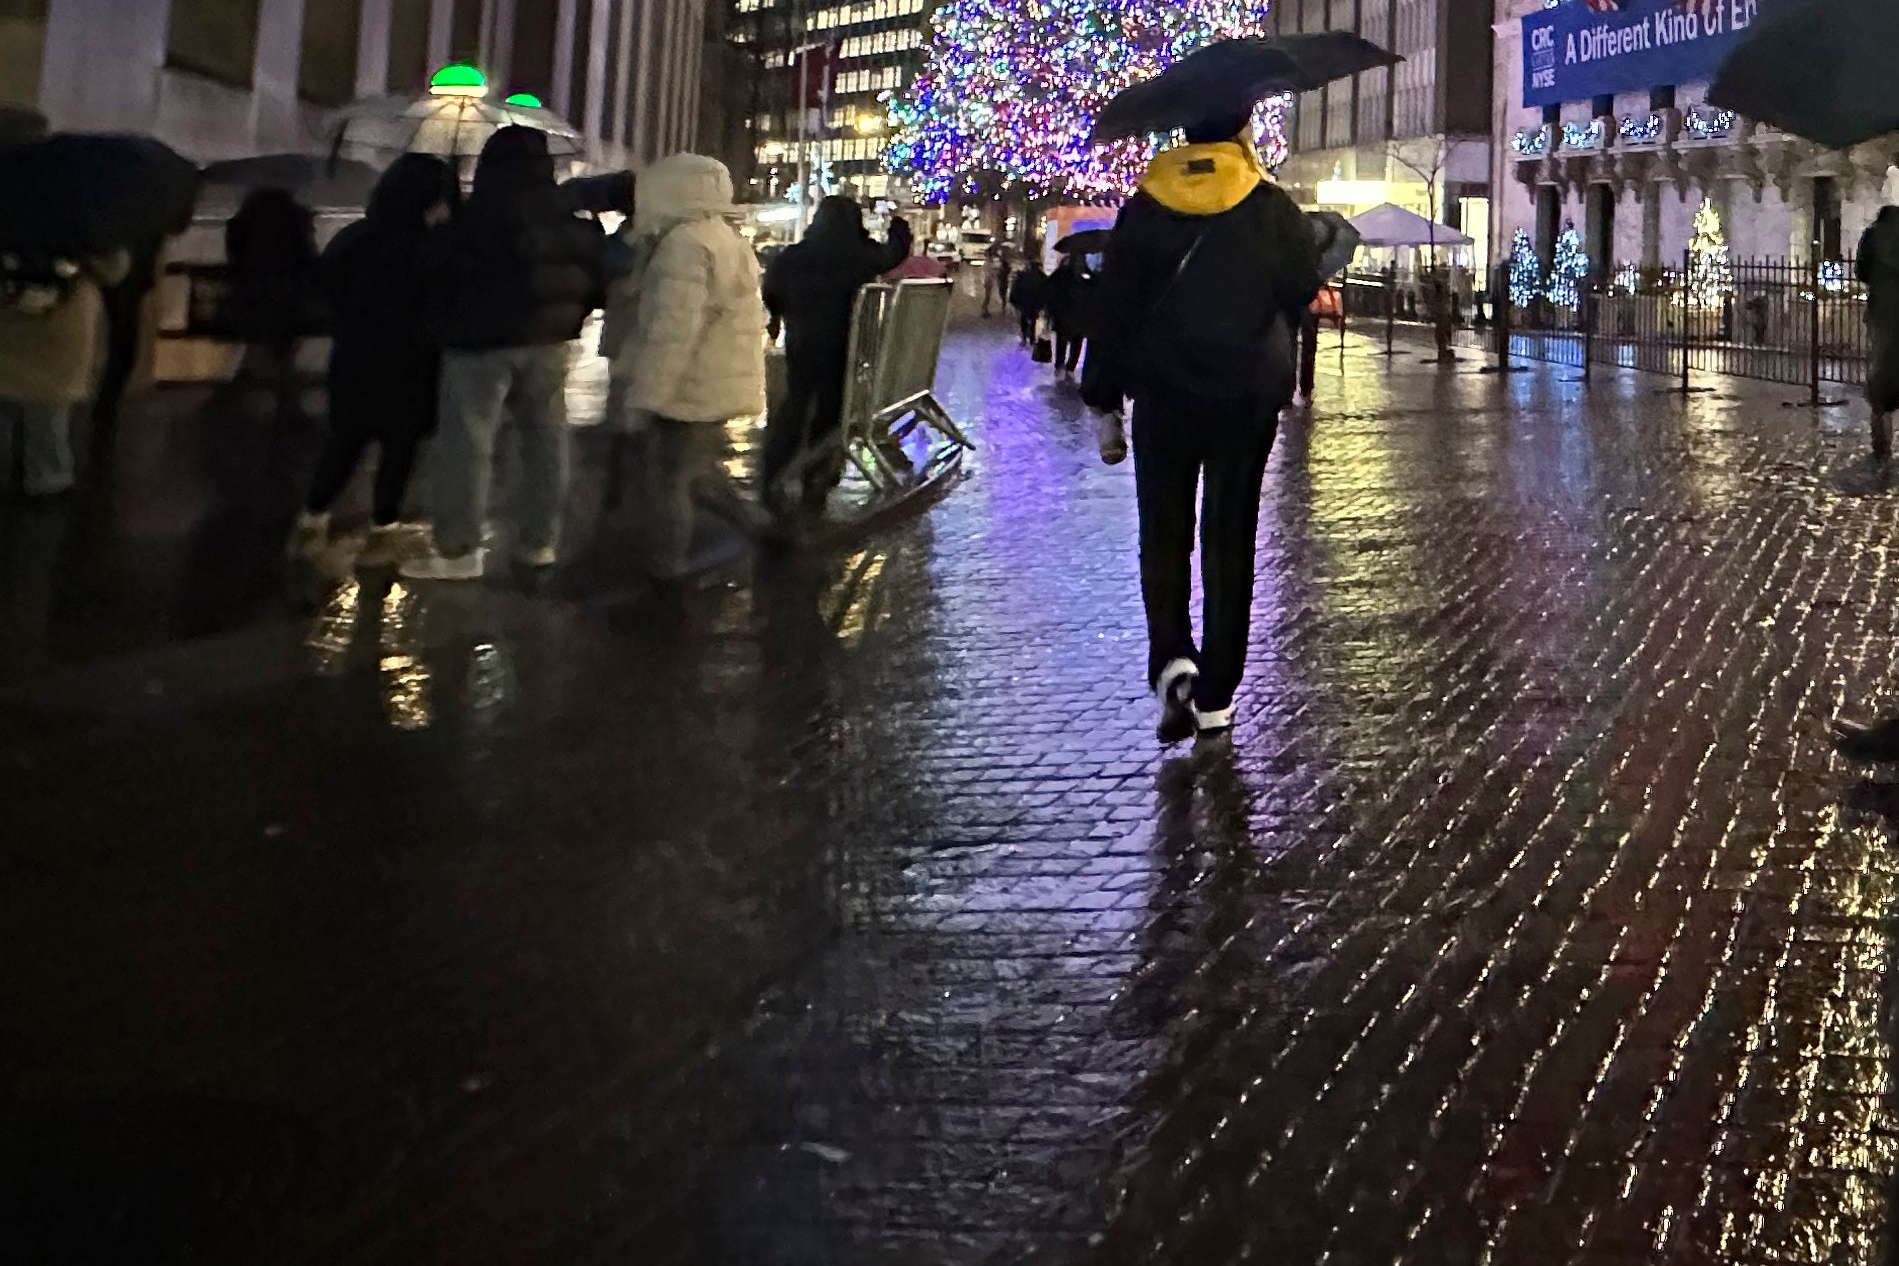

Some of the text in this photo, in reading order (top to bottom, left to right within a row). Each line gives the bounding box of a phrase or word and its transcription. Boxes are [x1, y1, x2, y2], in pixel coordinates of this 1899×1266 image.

[1531, 24, 1555, 51] CRC
[1565, 33, 1577, 66] A
[1580, 14, 1651, 63] Different
[1531, 68, 1556, 89] NYSE
